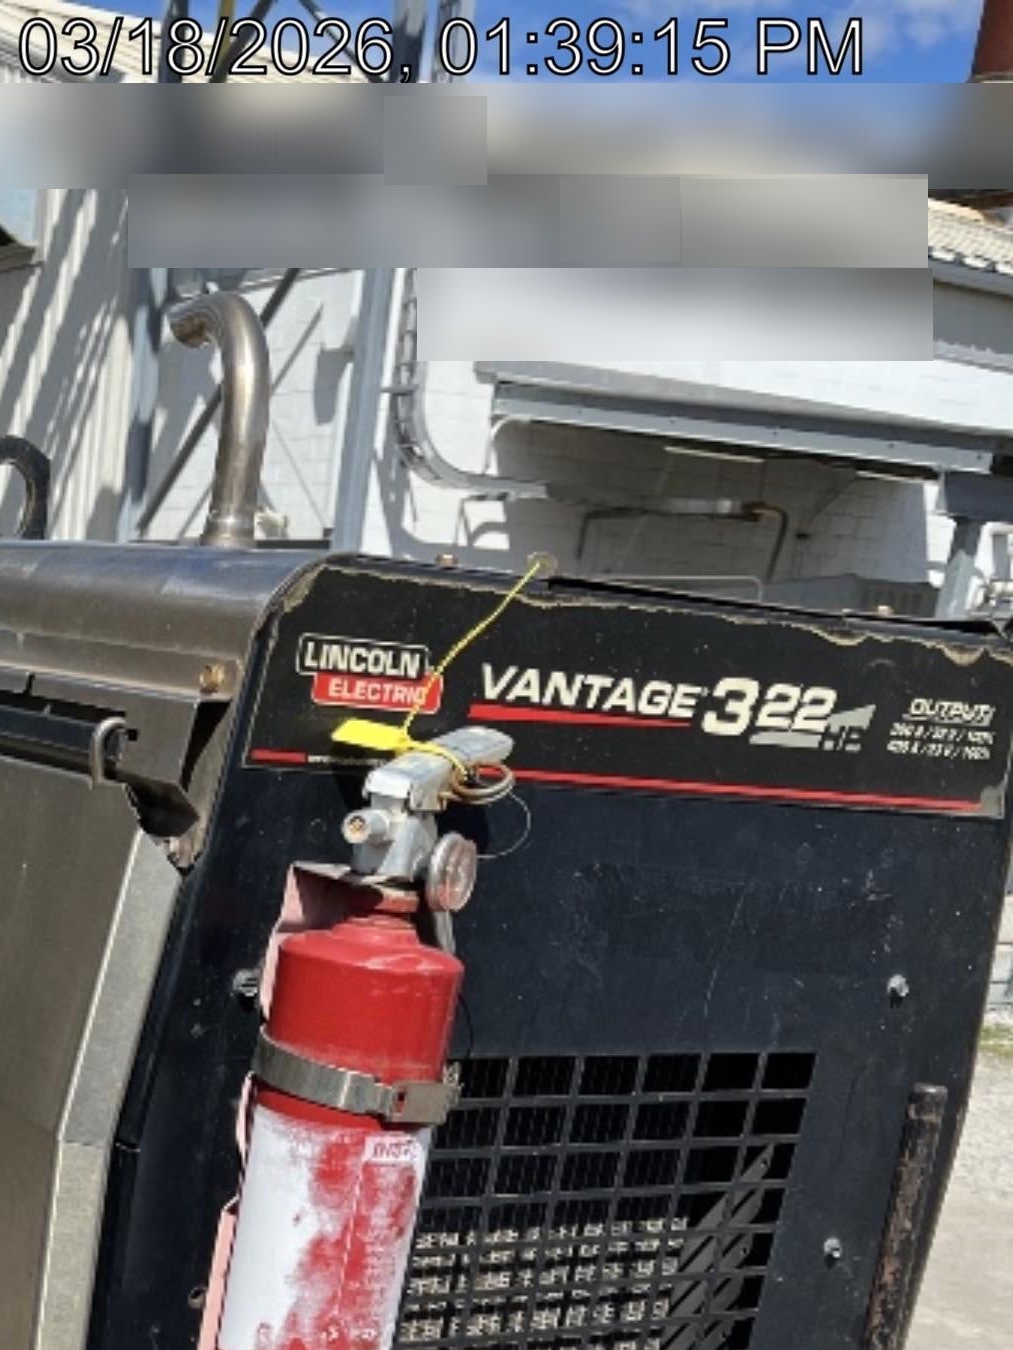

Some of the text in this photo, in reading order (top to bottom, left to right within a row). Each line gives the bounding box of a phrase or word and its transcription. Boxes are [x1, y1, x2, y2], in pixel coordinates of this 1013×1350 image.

[303, 641, 421, 678] LINCOLN
[480, 662, 702, 718] VANTAGE
[700, 676, 838, 736] 322
